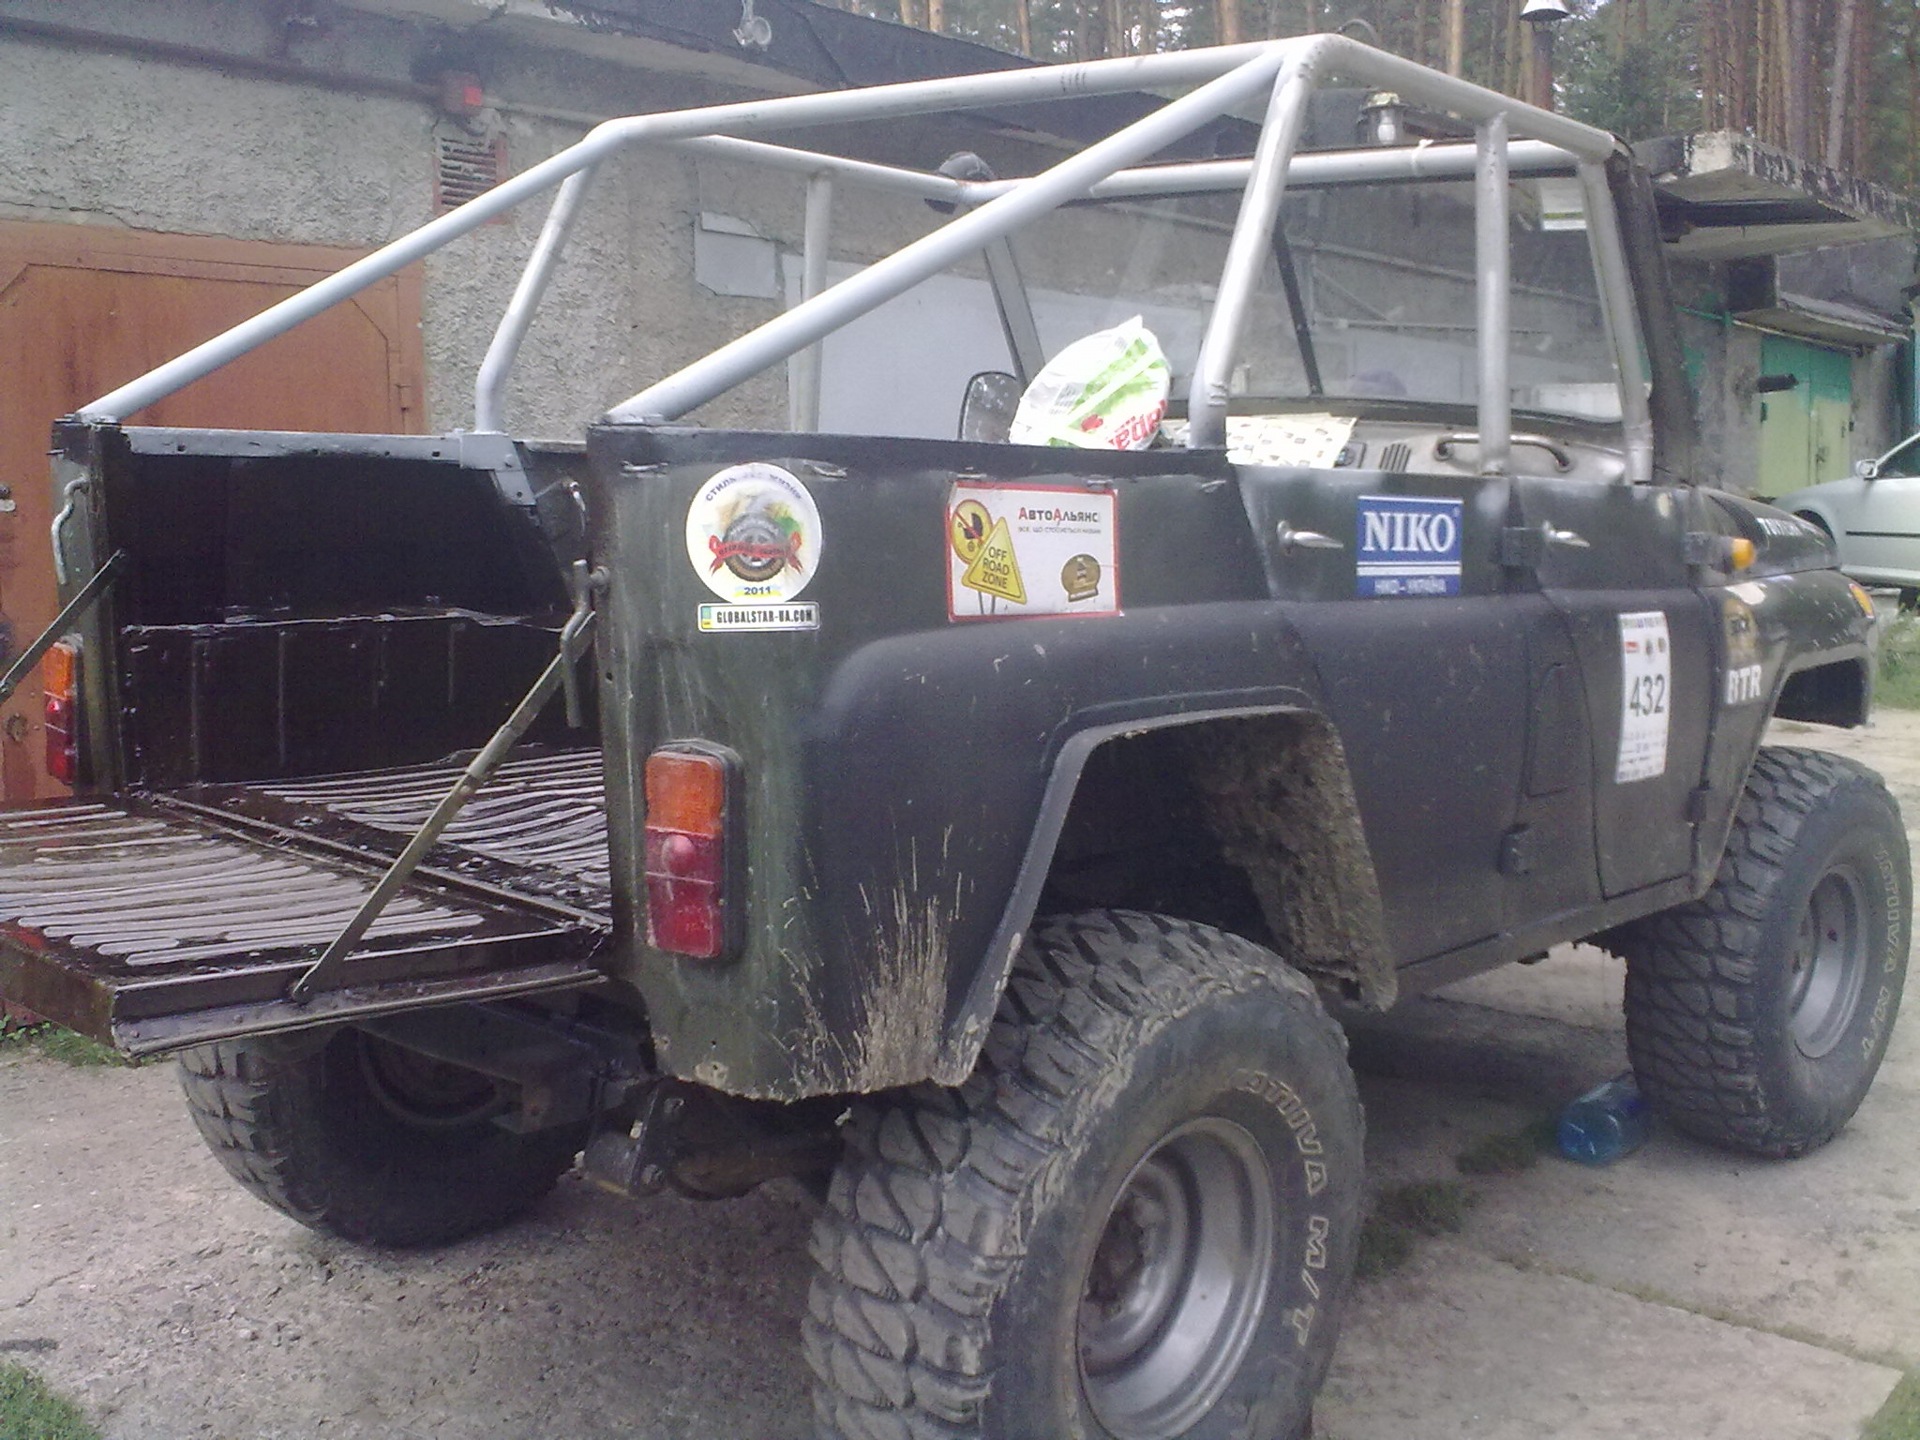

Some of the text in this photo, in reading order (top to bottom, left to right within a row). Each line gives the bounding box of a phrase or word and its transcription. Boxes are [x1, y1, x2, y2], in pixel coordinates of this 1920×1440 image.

[1361, 510, 1457, 553] NIKO
[988, 546, 1008, 561] OFF
[982, 557, 1010, 576] ROAD
[982, 570, 1009, 590] ZONE
[744, 586, 771, 596] 2011
[716, 609, 813, 625] GLOBALSTAR-UA.COM
[1629, 673, 1666, 718] 432
[1291, 1215, 1330, 1346] M/T
